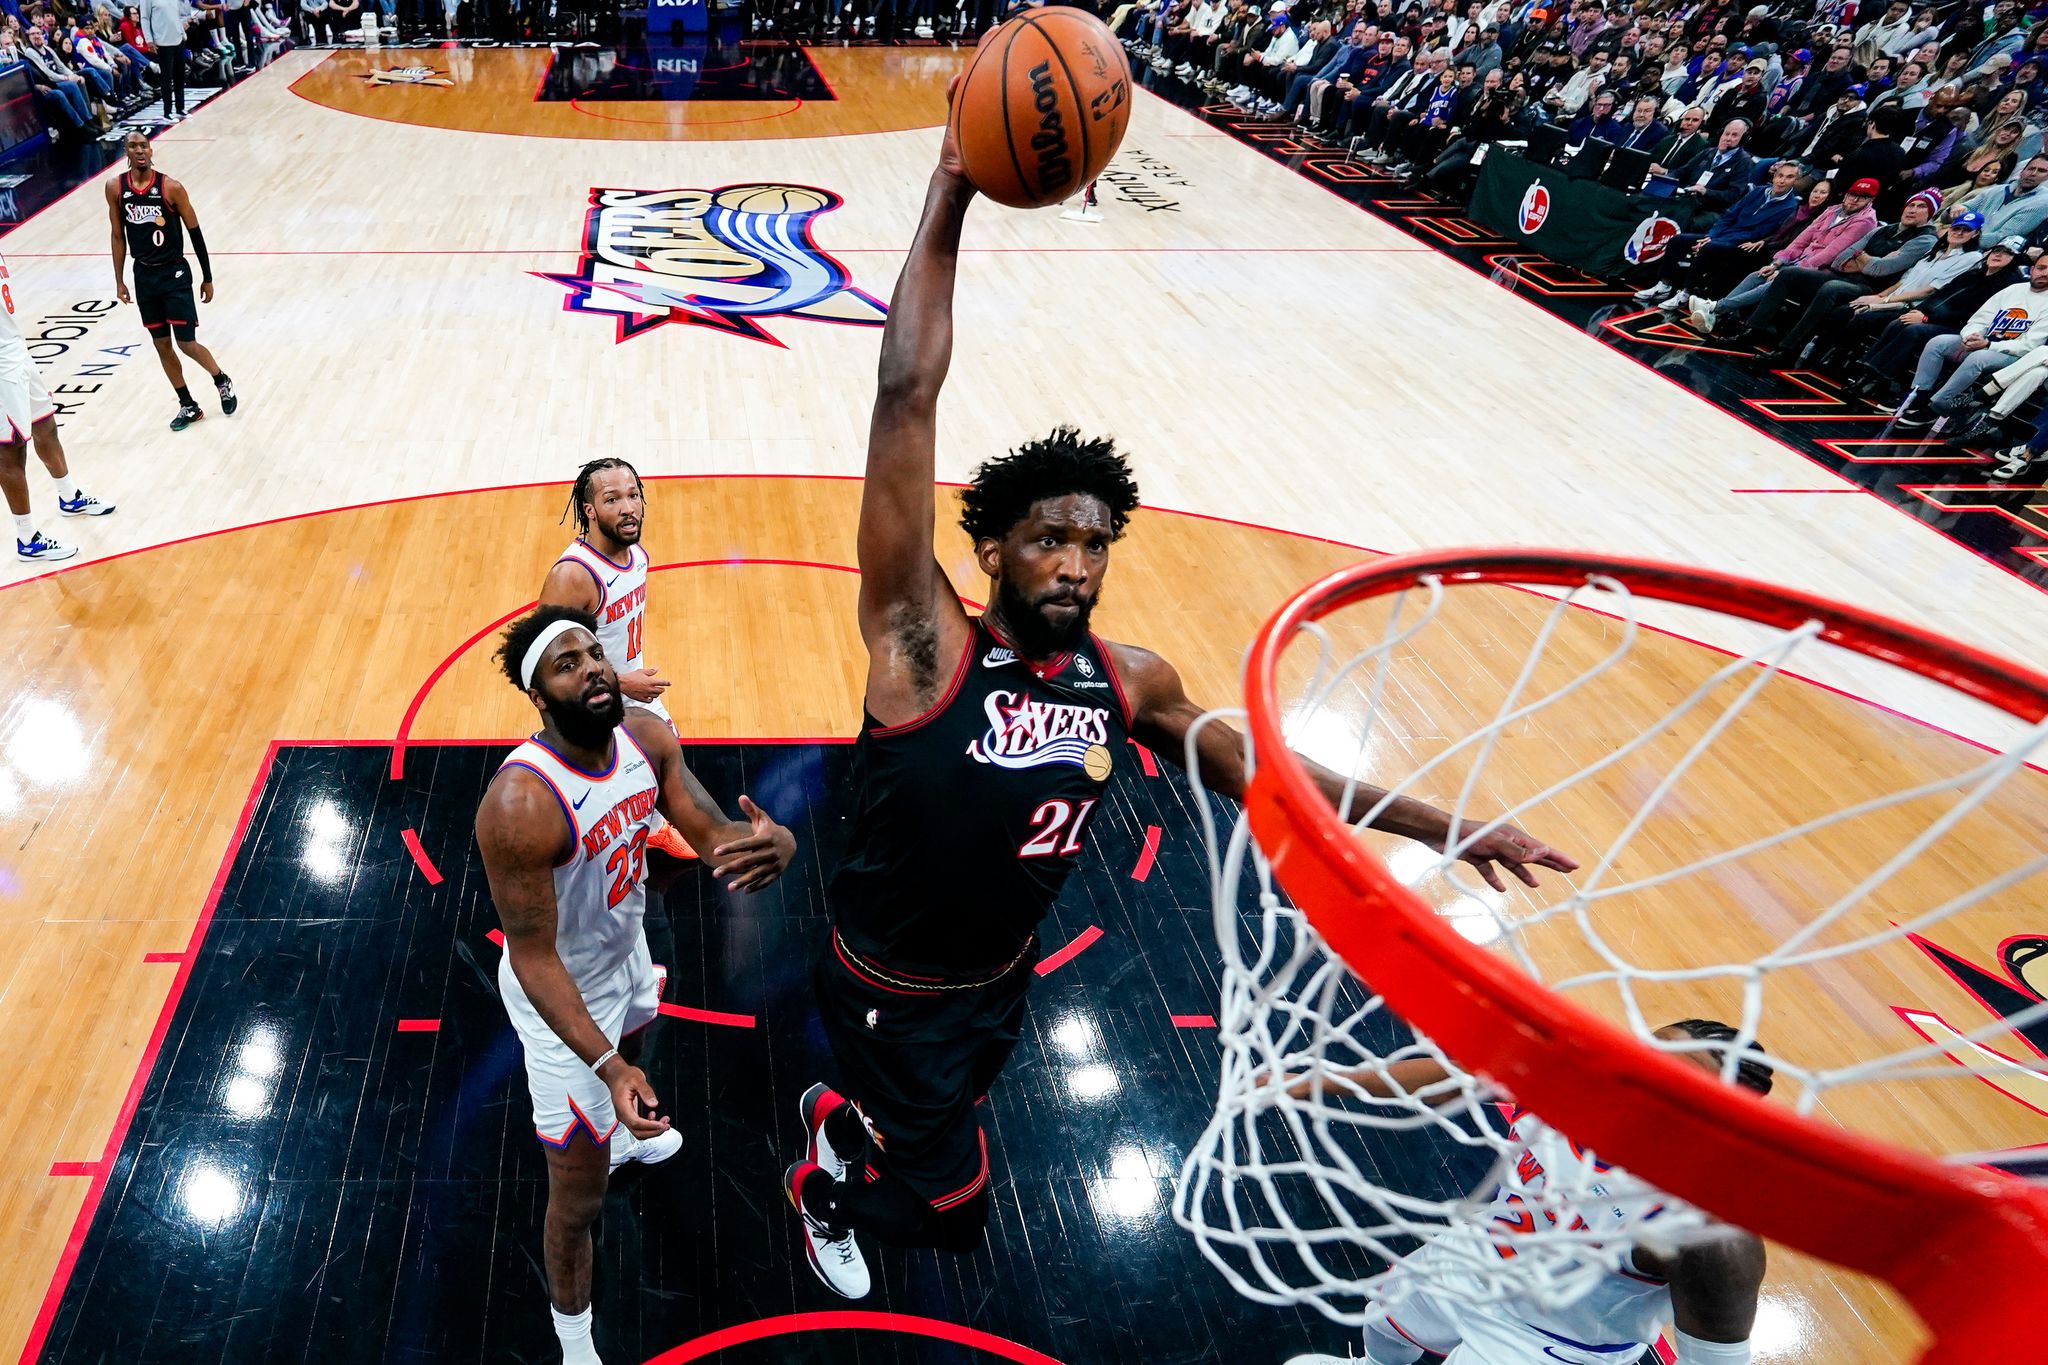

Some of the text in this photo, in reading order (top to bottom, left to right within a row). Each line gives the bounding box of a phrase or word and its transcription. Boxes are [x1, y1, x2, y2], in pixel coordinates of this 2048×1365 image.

[1123, 149, 1197, 187] ARENA
[125, 202, 163, 222] SIXERS
[152, 229, 165, 247] 0
[1, 283, 15, 315] 8
[25, 299, 118, 374] obile
[54, 343, 142, 427] RENA
[606, 590, 634, 625] NEW
[626, 610, 643, 662] 11
[1073, 681, 1109, 689] crypto.com
[966, 690, 1110, 763] SIXERS
[582, 786, 657, 862] NEW YORK
[1018, 797, 1099, 858] 21
[606, 824, 650, 911] 23
